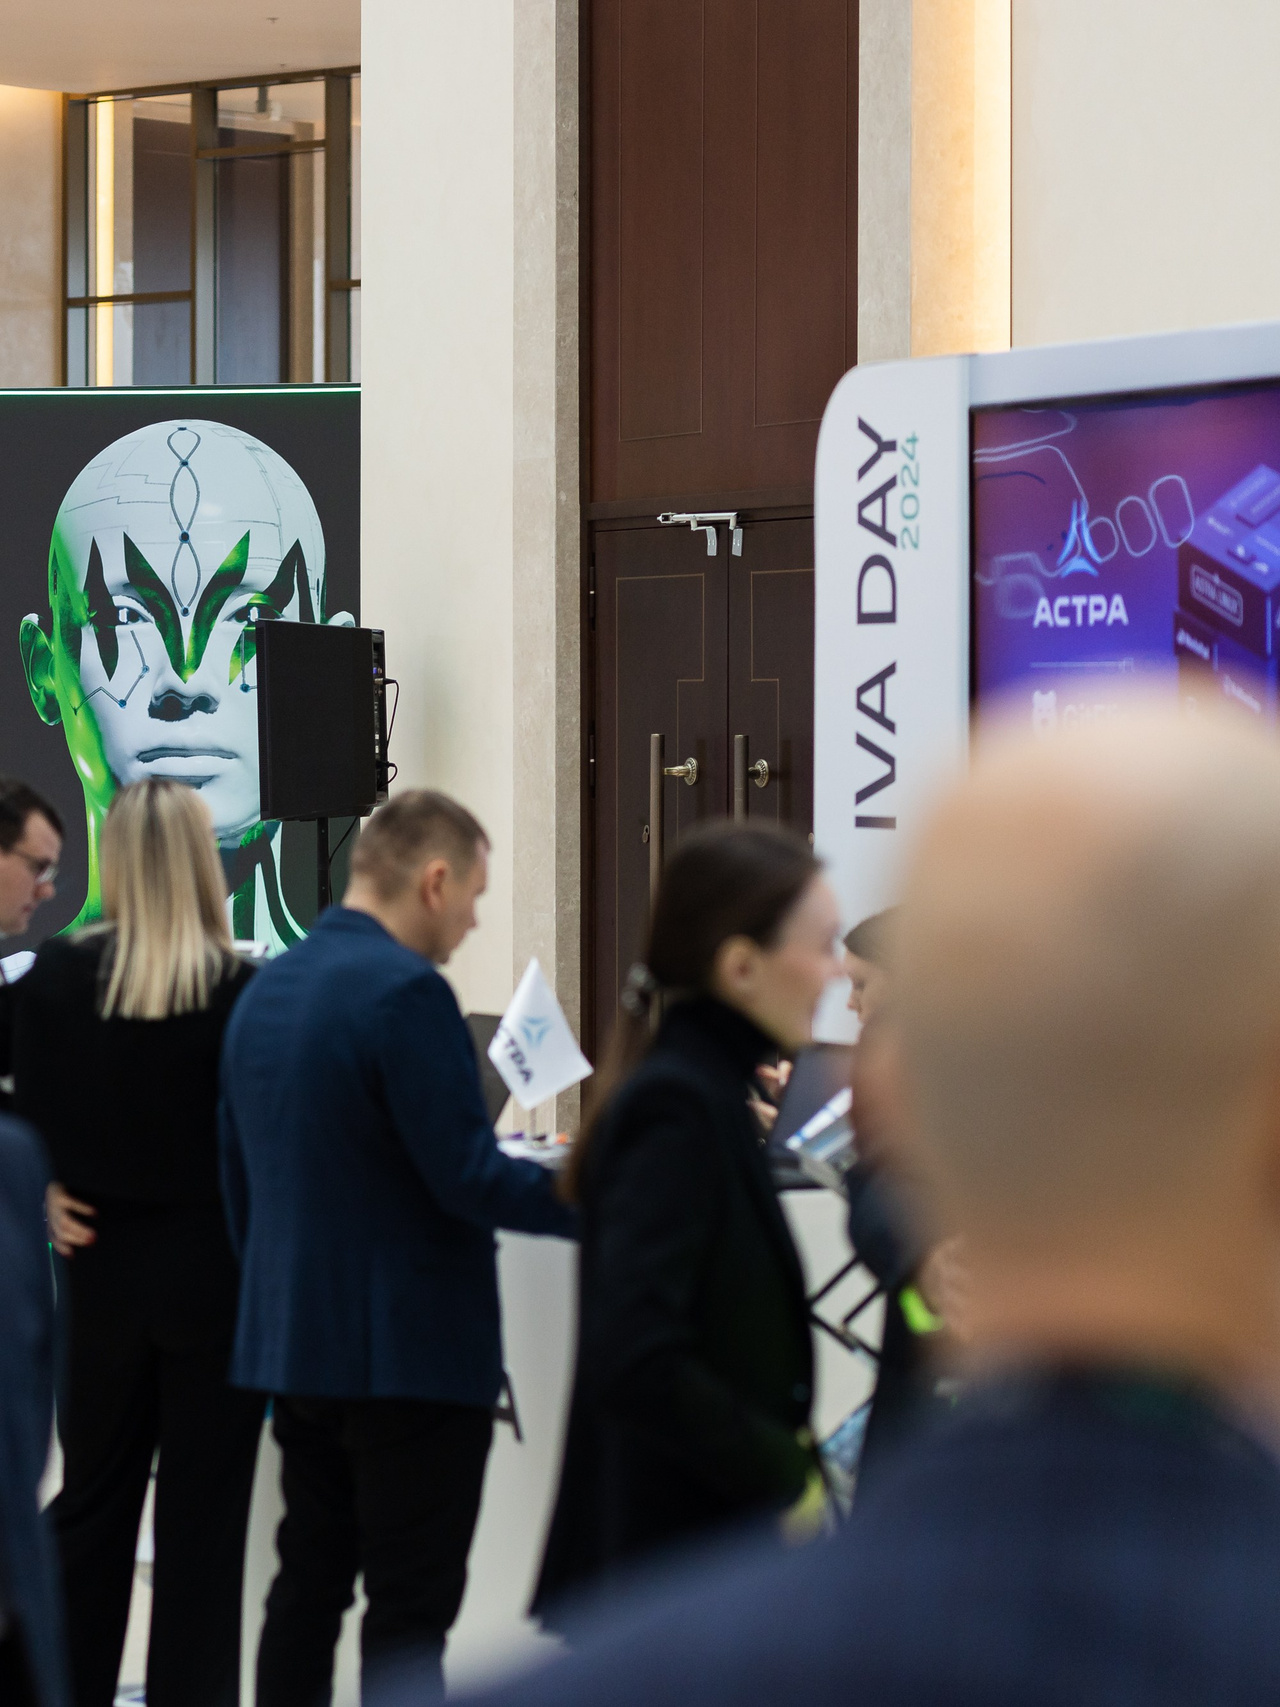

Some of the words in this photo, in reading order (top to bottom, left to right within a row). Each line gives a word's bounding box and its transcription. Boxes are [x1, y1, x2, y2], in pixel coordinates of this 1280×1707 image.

[856, 416, 897, 625] DAY
[900, 431, 919, 550] 2024
[1032, 593, 1130, 629] АСТРА
[854, 661, 897, 829] IVA
